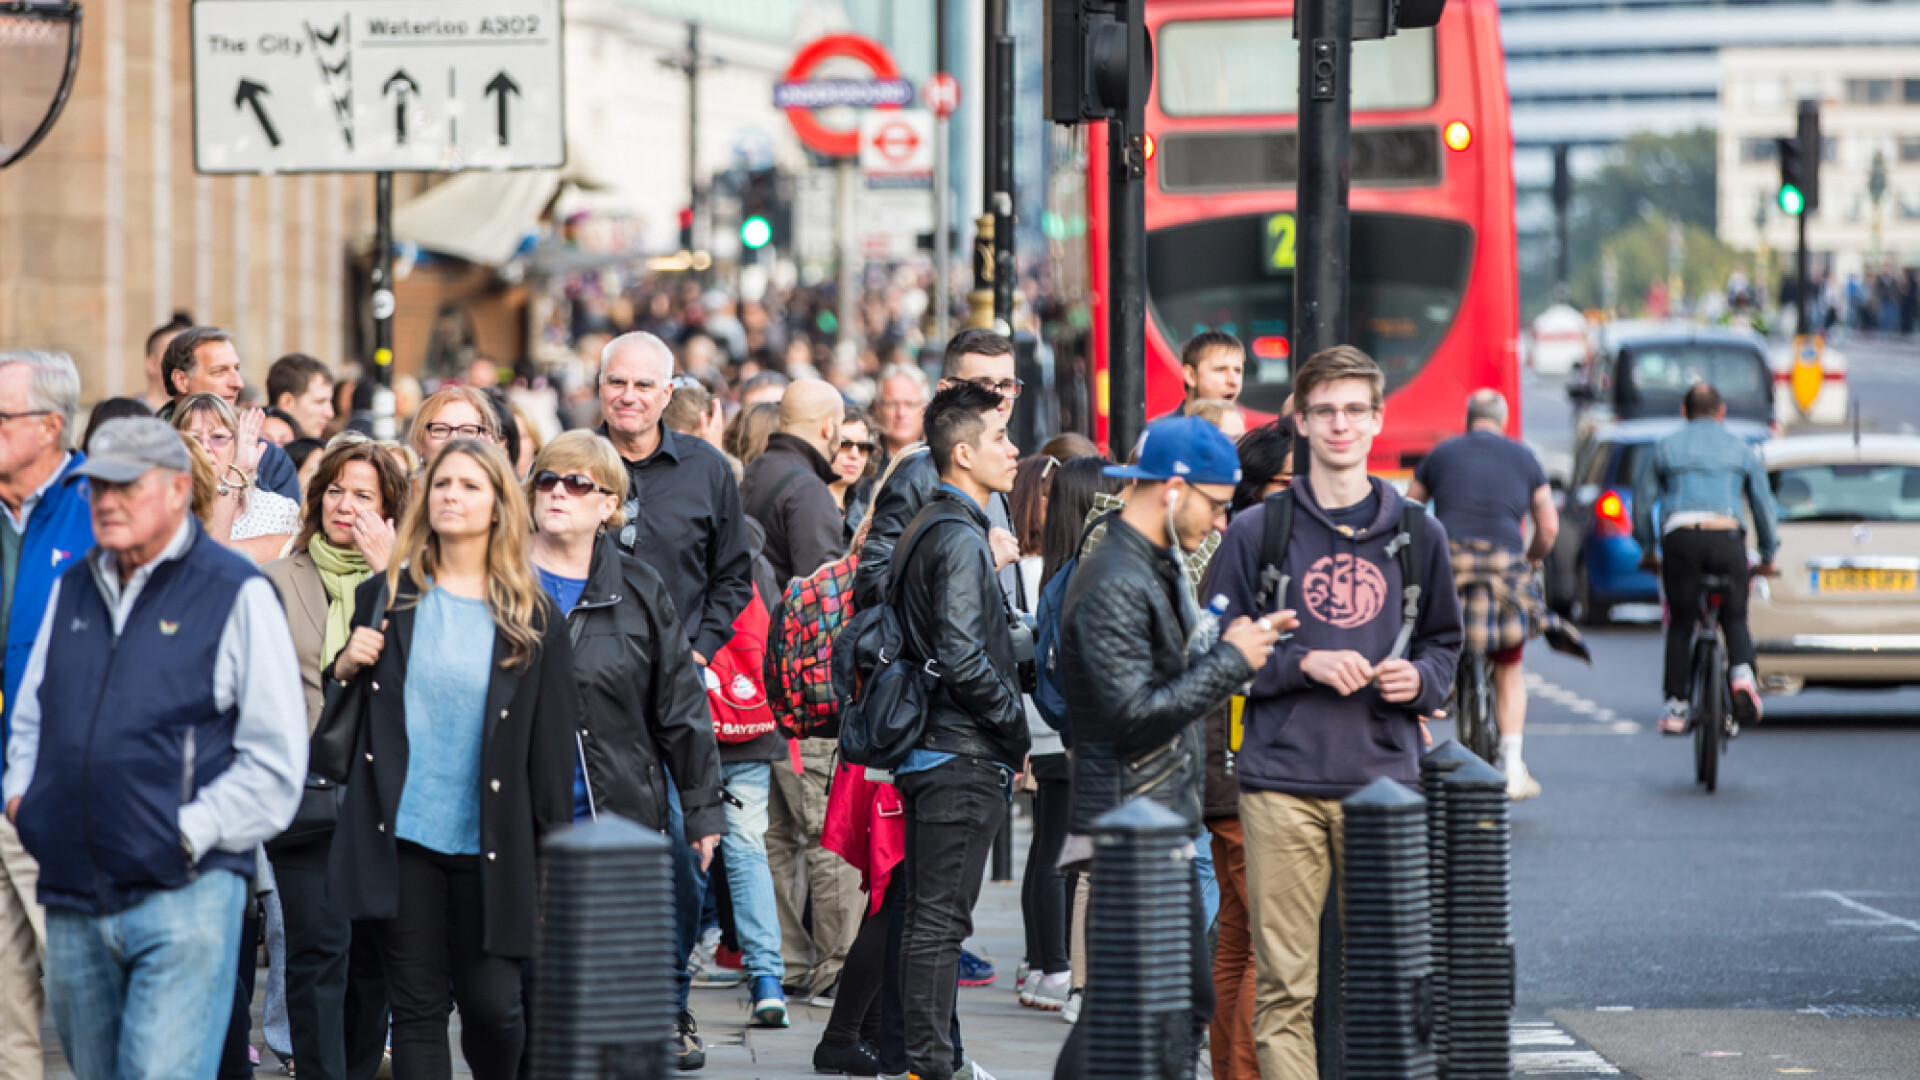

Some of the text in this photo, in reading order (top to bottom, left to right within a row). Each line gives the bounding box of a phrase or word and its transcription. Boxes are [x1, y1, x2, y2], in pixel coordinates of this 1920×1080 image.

[369, 15, 540, 35] Waterloo A302
[208, 34, 303, 57] The City
[1268, 213, 1297, 268] 2
[723, 721, 775, 735] BAYERN
